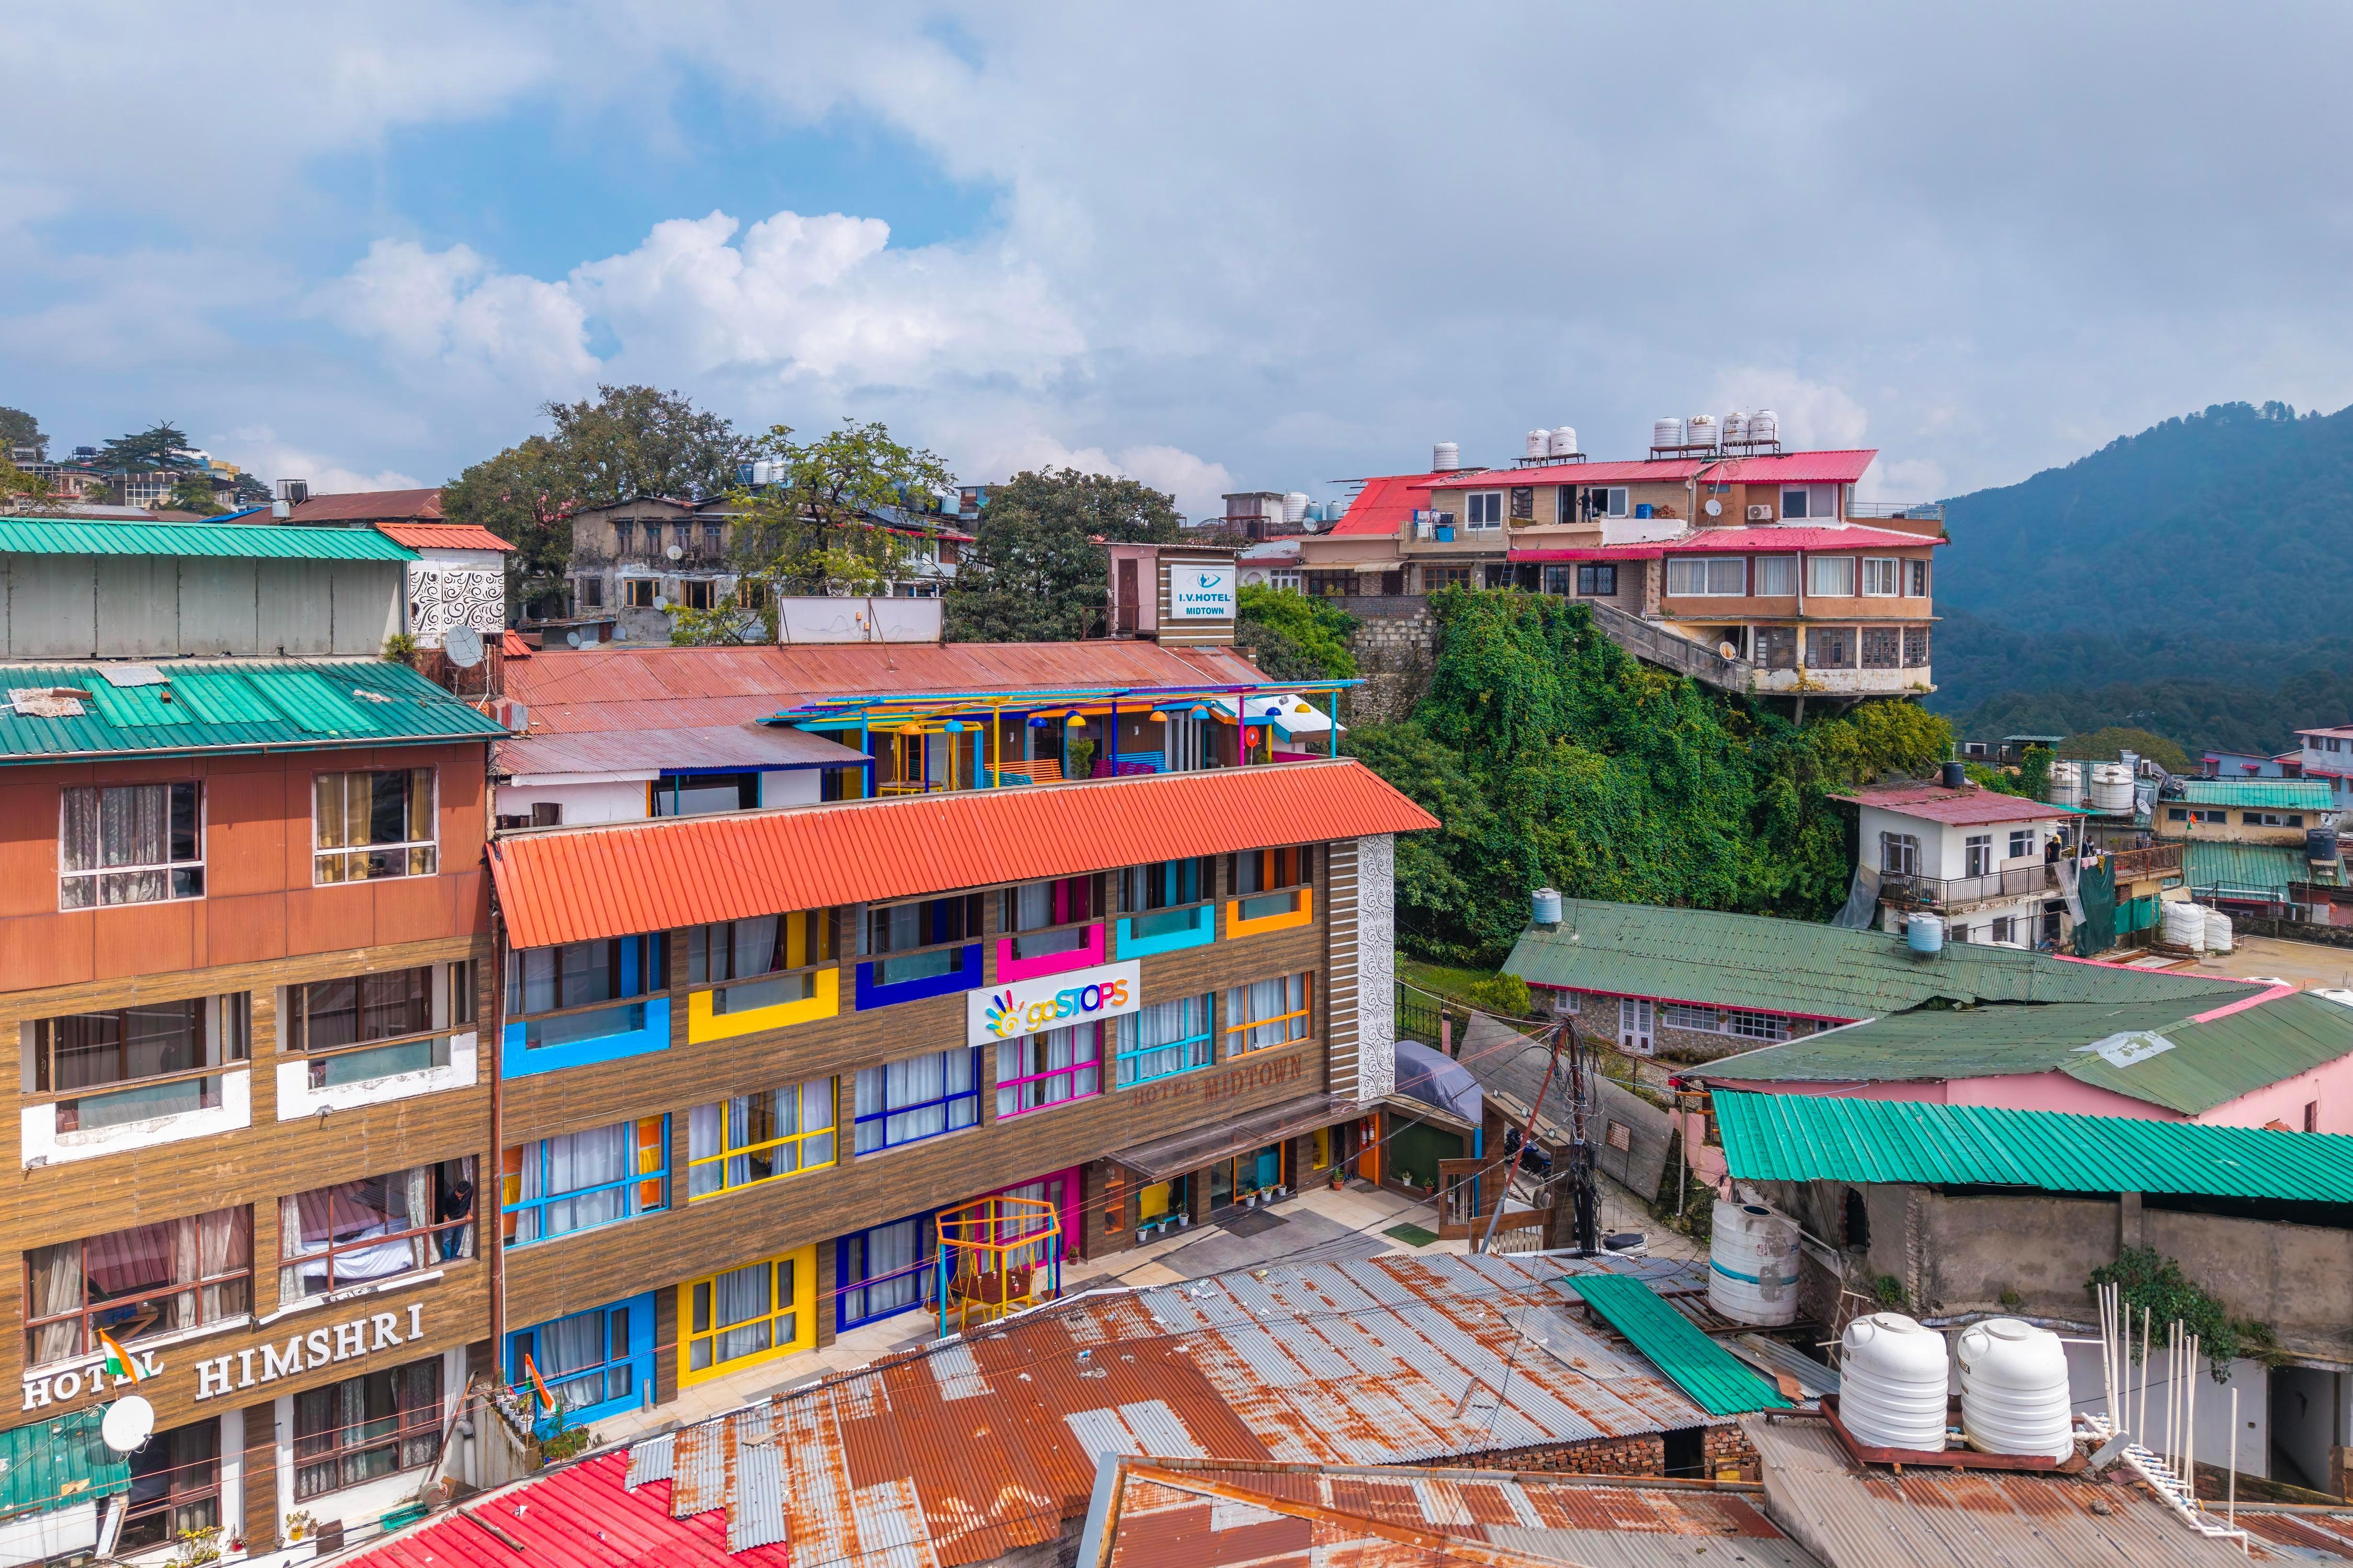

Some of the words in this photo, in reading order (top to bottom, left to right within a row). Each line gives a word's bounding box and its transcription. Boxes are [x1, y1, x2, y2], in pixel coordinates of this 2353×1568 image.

[1026, 979, 1129, 1032] goSTOPS
[1133, 1075, 1195, 1106] HOTEL
[1204, 1053, 1303, 1103] MIDTOWN
[22, 1350, 164, 1411] HOTL
[195, 1303, 424, 1401] HIMSHRI
